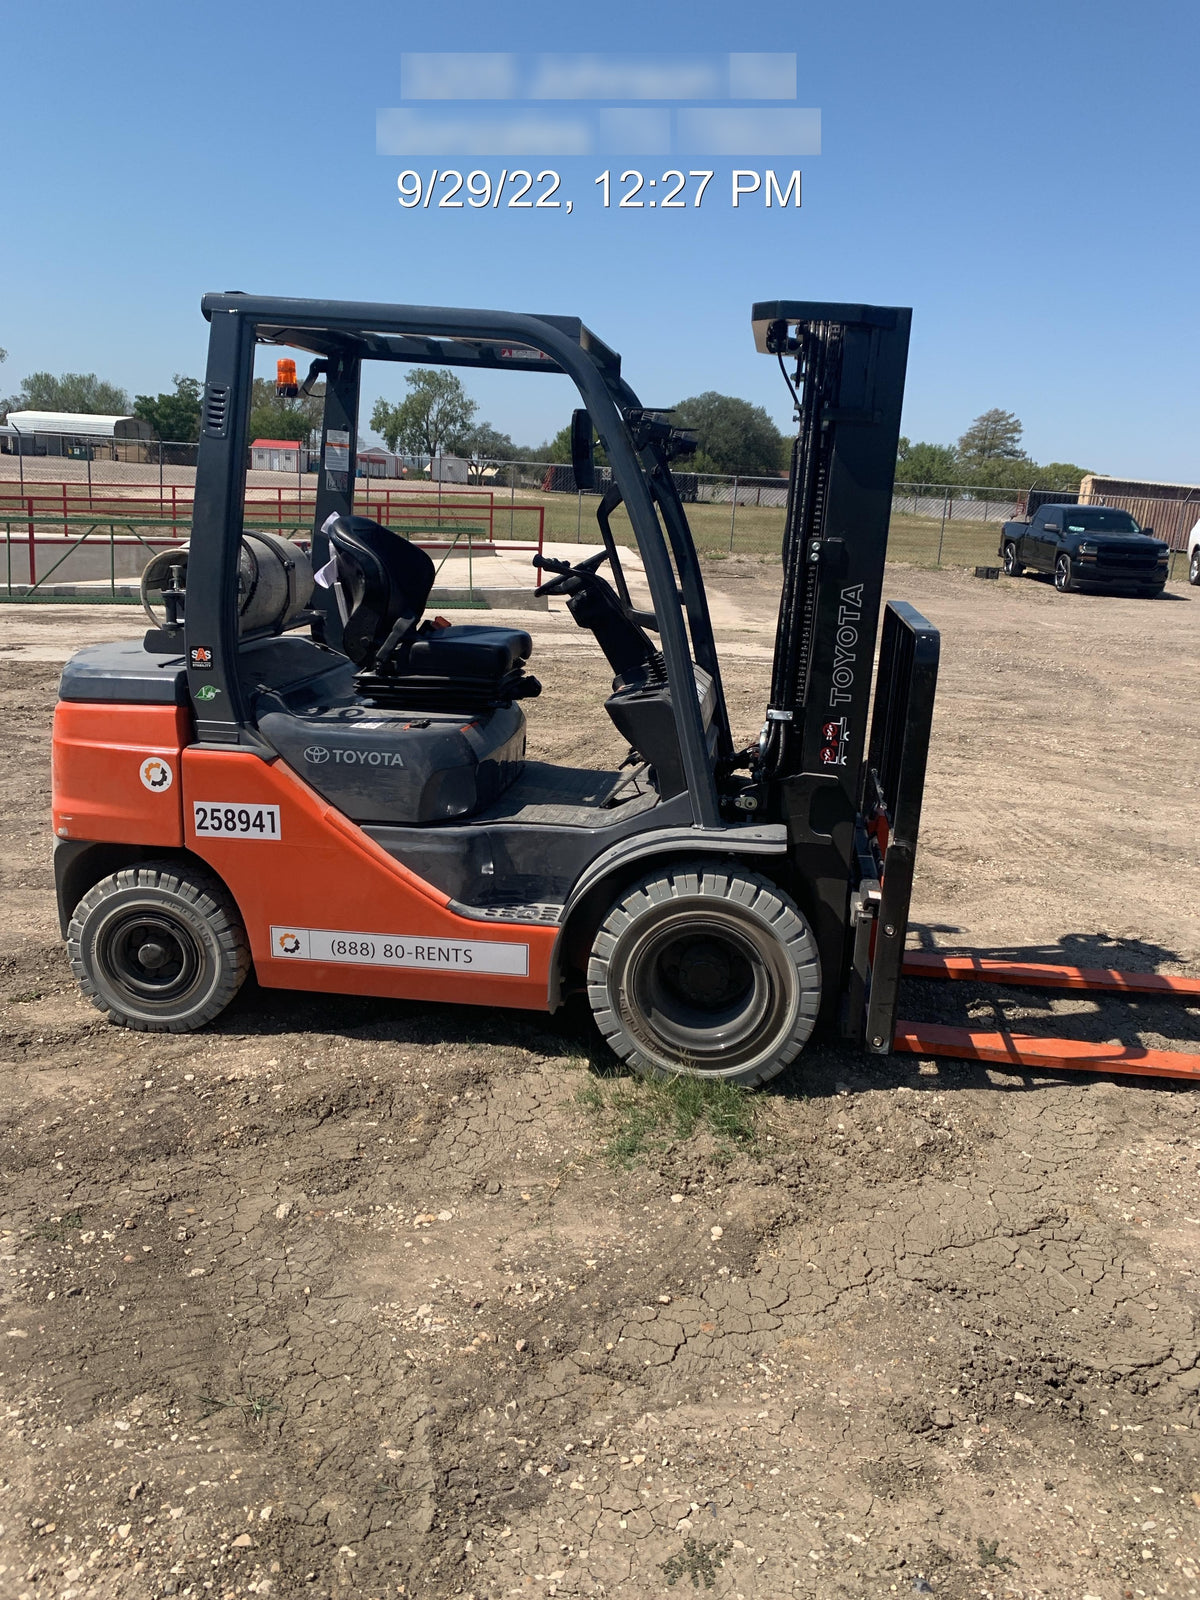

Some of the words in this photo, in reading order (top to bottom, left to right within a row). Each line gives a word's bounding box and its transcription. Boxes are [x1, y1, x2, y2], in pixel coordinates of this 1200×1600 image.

[191, 647, 212, 661] SAS
[829, 583, 864, 707] TOYOTA
[332, 749, 404, 767] TOYOTA
[195, 807, 276, 833] 258941
[331, 939, 376, 959] (888)
[383, 943, 473, 964] 80-RENTS
